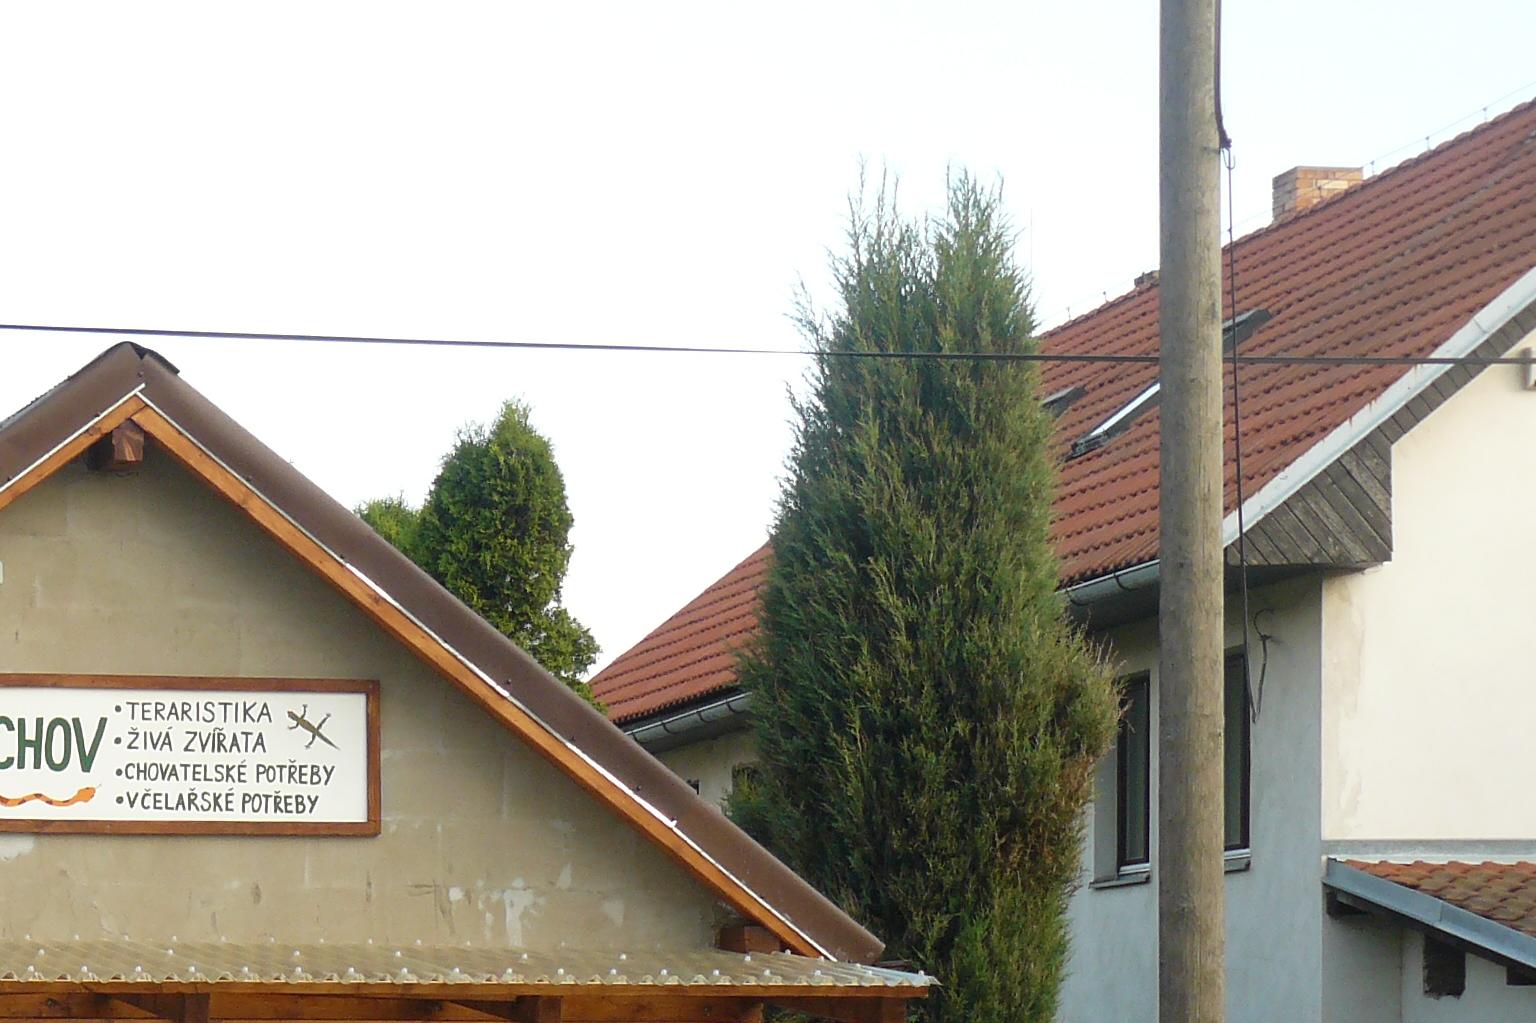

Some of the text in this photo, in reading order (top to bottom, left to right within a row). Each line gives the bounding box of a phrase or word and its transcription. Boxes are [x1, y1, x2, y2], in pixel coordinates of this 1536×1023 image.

[126, 701, 273, 723] TERARISTIKA
[126, 726, 267, 753] ŽIVÁ ZVÍŘATA
[124, 759, 336, 785] CHOVATELSKÉ POTŘEBY
[126, 788, 319, 814] VČELAŘSKÉ POTŘEBY
